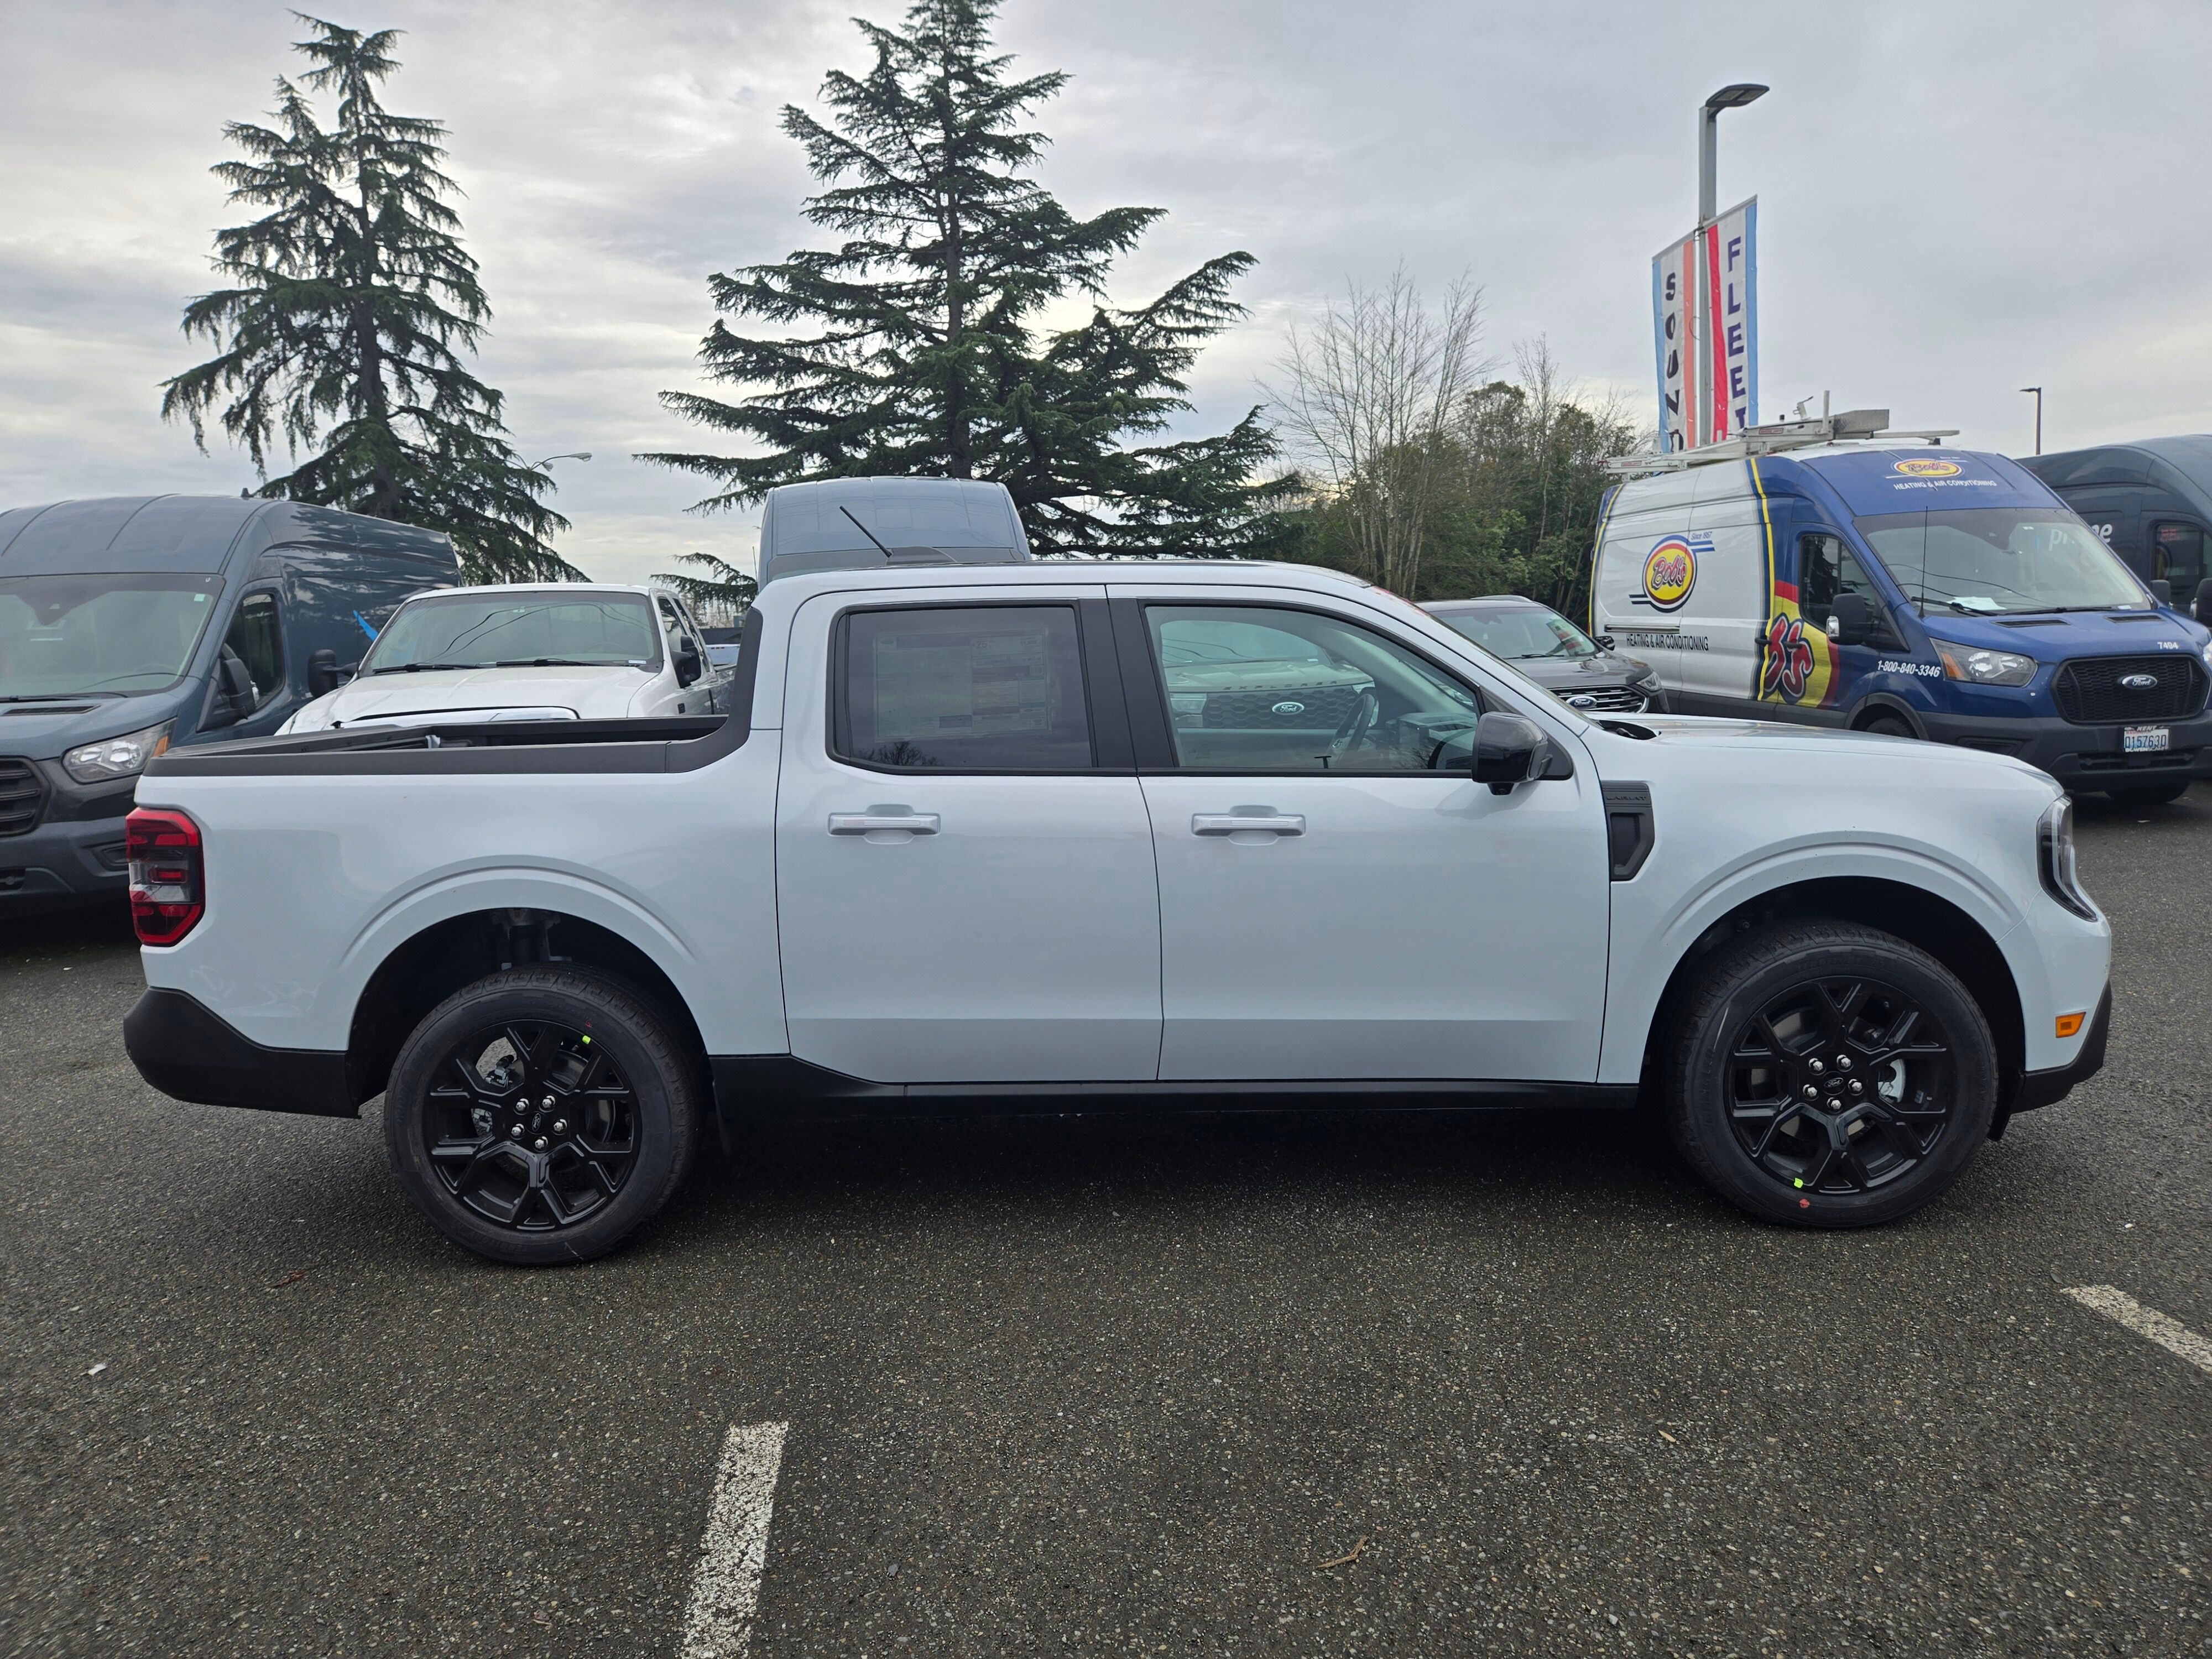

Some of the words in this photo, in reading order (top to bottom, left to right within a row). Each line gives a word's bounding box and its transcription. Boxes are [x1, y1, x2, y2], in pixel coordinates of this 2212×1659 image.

[1728, 236, 1746, 429] FLEET
[1893, 481, 1927, 491] HEATING
[1651, 555, 1687, 590] Bob's
[1626, 633, 1650, 647] HEATING
[1650, 634, 1655, 648] &
[1656, 634, 1666, 648] AIR
[1665, 635, 1709, 651] CONDITIONING
[2157, 641, 2179, 650] 7494
[1877, 660, 1941, 677] 1-800-840-3346
